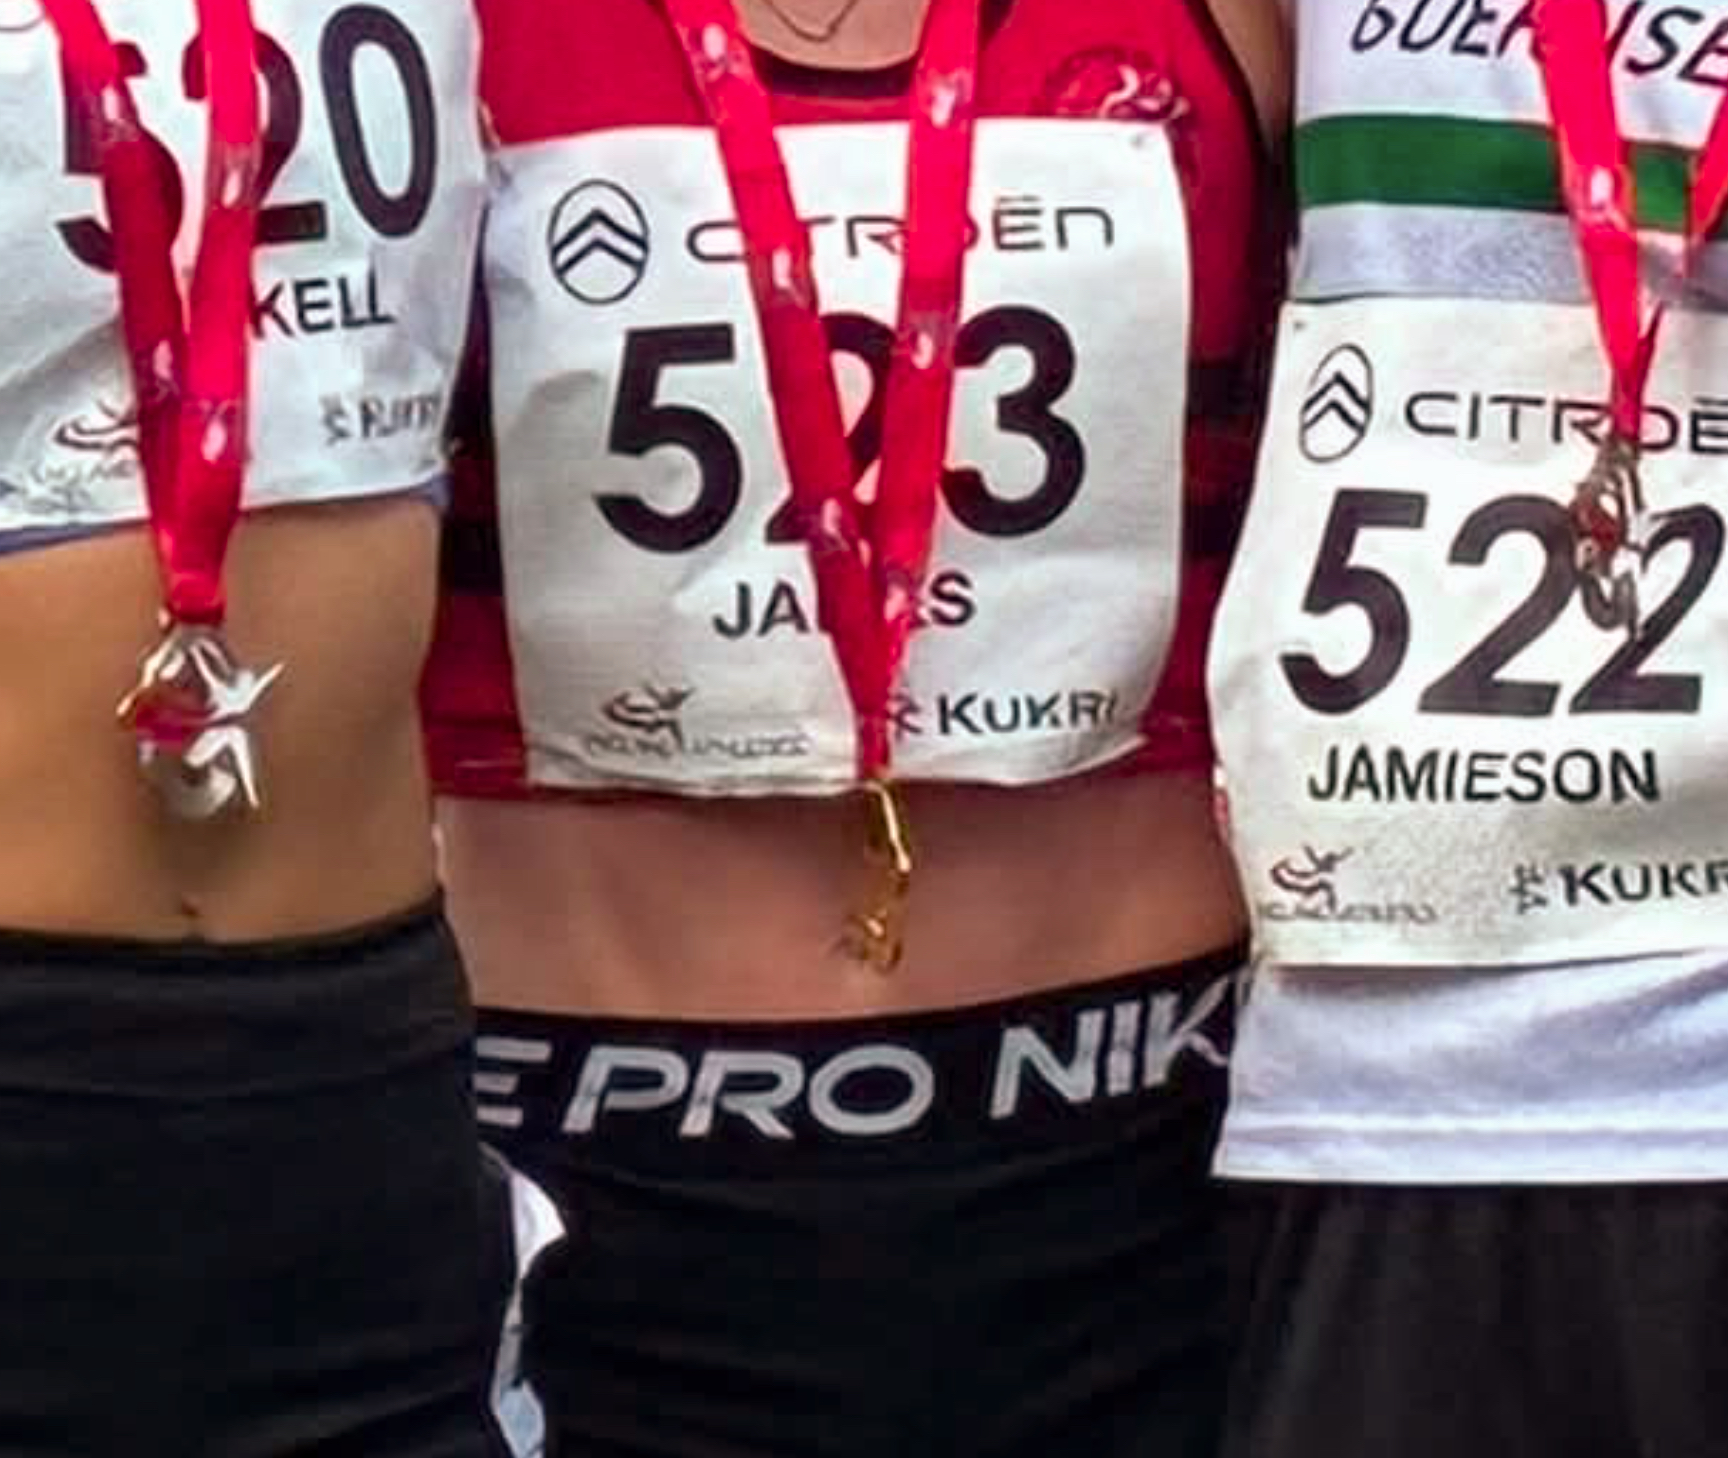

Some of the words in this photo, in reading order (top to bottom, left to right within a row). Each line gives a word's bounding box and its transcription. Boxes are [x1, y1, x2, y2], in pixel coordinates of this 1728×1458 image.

[55, 4, 438, 274] 520
[593, 306, 1087, 553] 523
[712, 571, 976, 639] JAS
[1279, 489, 1726, 717] 522
[938, 690, 1116, 735] KUKRI
[1309, 747, 1660, 803] JAMIESON
[562, 1044, 934, 1140] PRO
[989, 974, 1238, 1120] NIK
